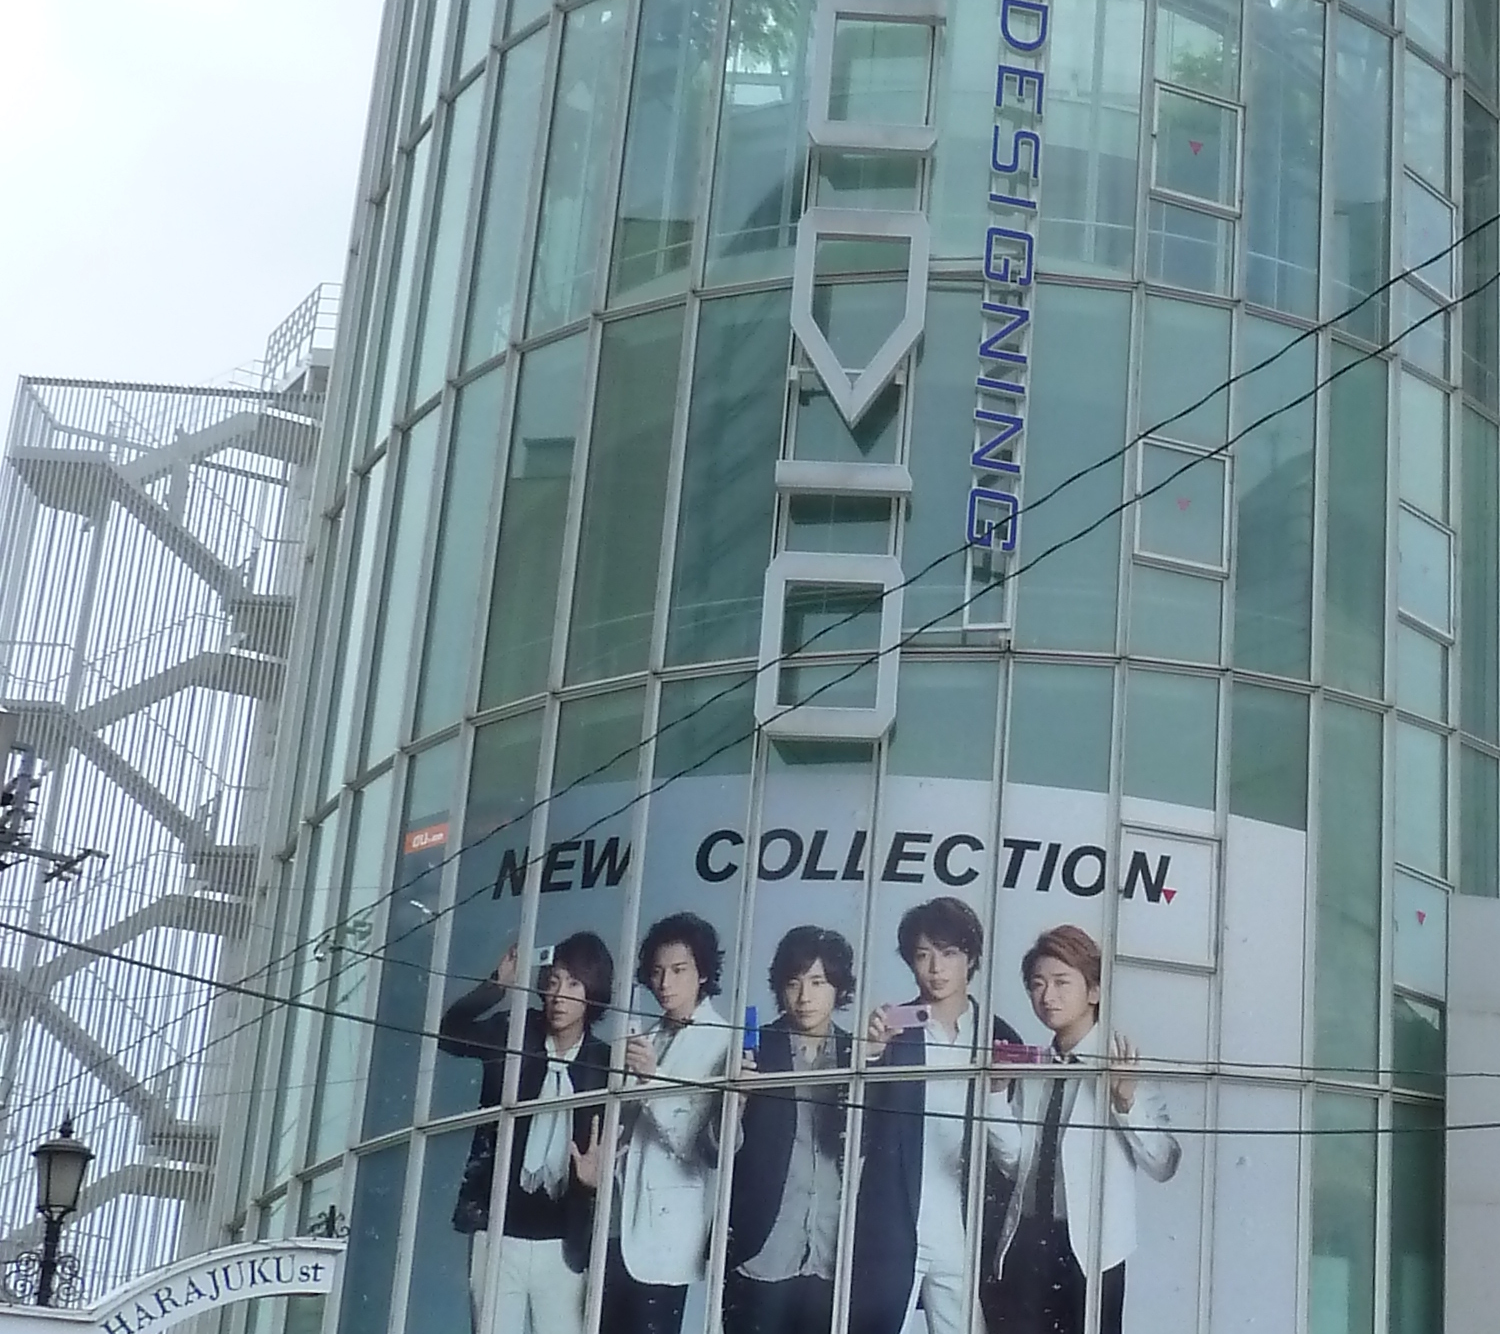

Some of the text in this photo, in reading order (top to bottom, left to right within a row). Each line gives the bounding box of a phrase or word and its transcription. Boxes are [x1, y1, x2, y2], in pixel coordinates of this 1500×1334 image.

[492, 828, 1171, 904] NEW COLLECTION
[297, 1262, 326, 1283] st
